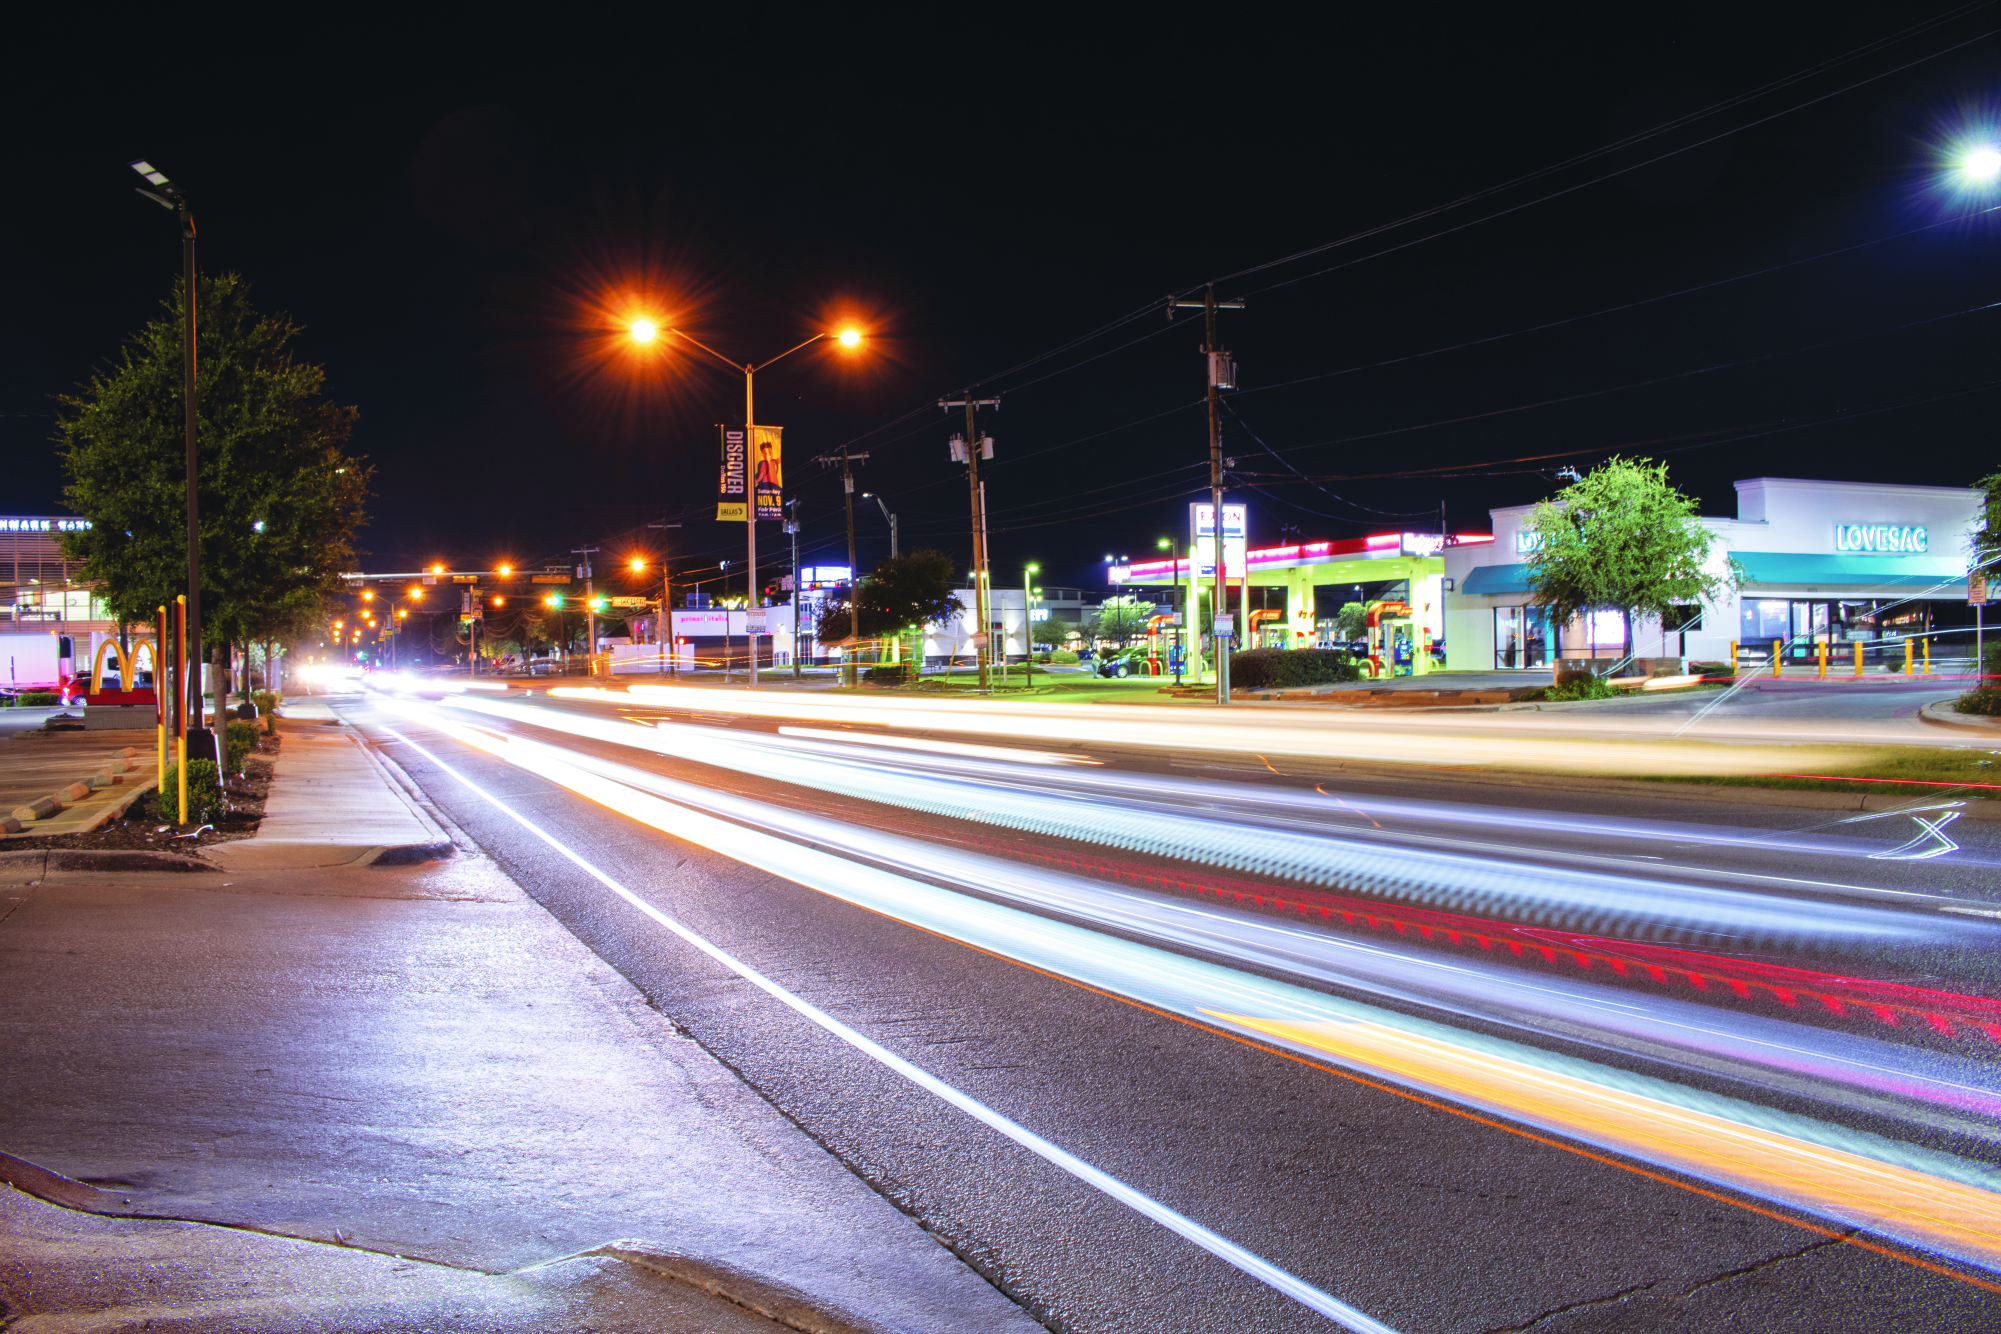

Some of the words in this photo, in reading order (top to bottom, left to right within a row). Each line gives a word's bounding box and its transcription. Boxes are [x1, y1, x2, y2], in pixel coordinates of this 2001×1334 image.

[726, 431, 744, 494] DISCOVER
[757, 495, 775, 506] NOV.
[775, 495, 782, 506] 9
[1200, 511, 1241, 522] EXON
[1837, 525, 1928, 552] LOVESAC
